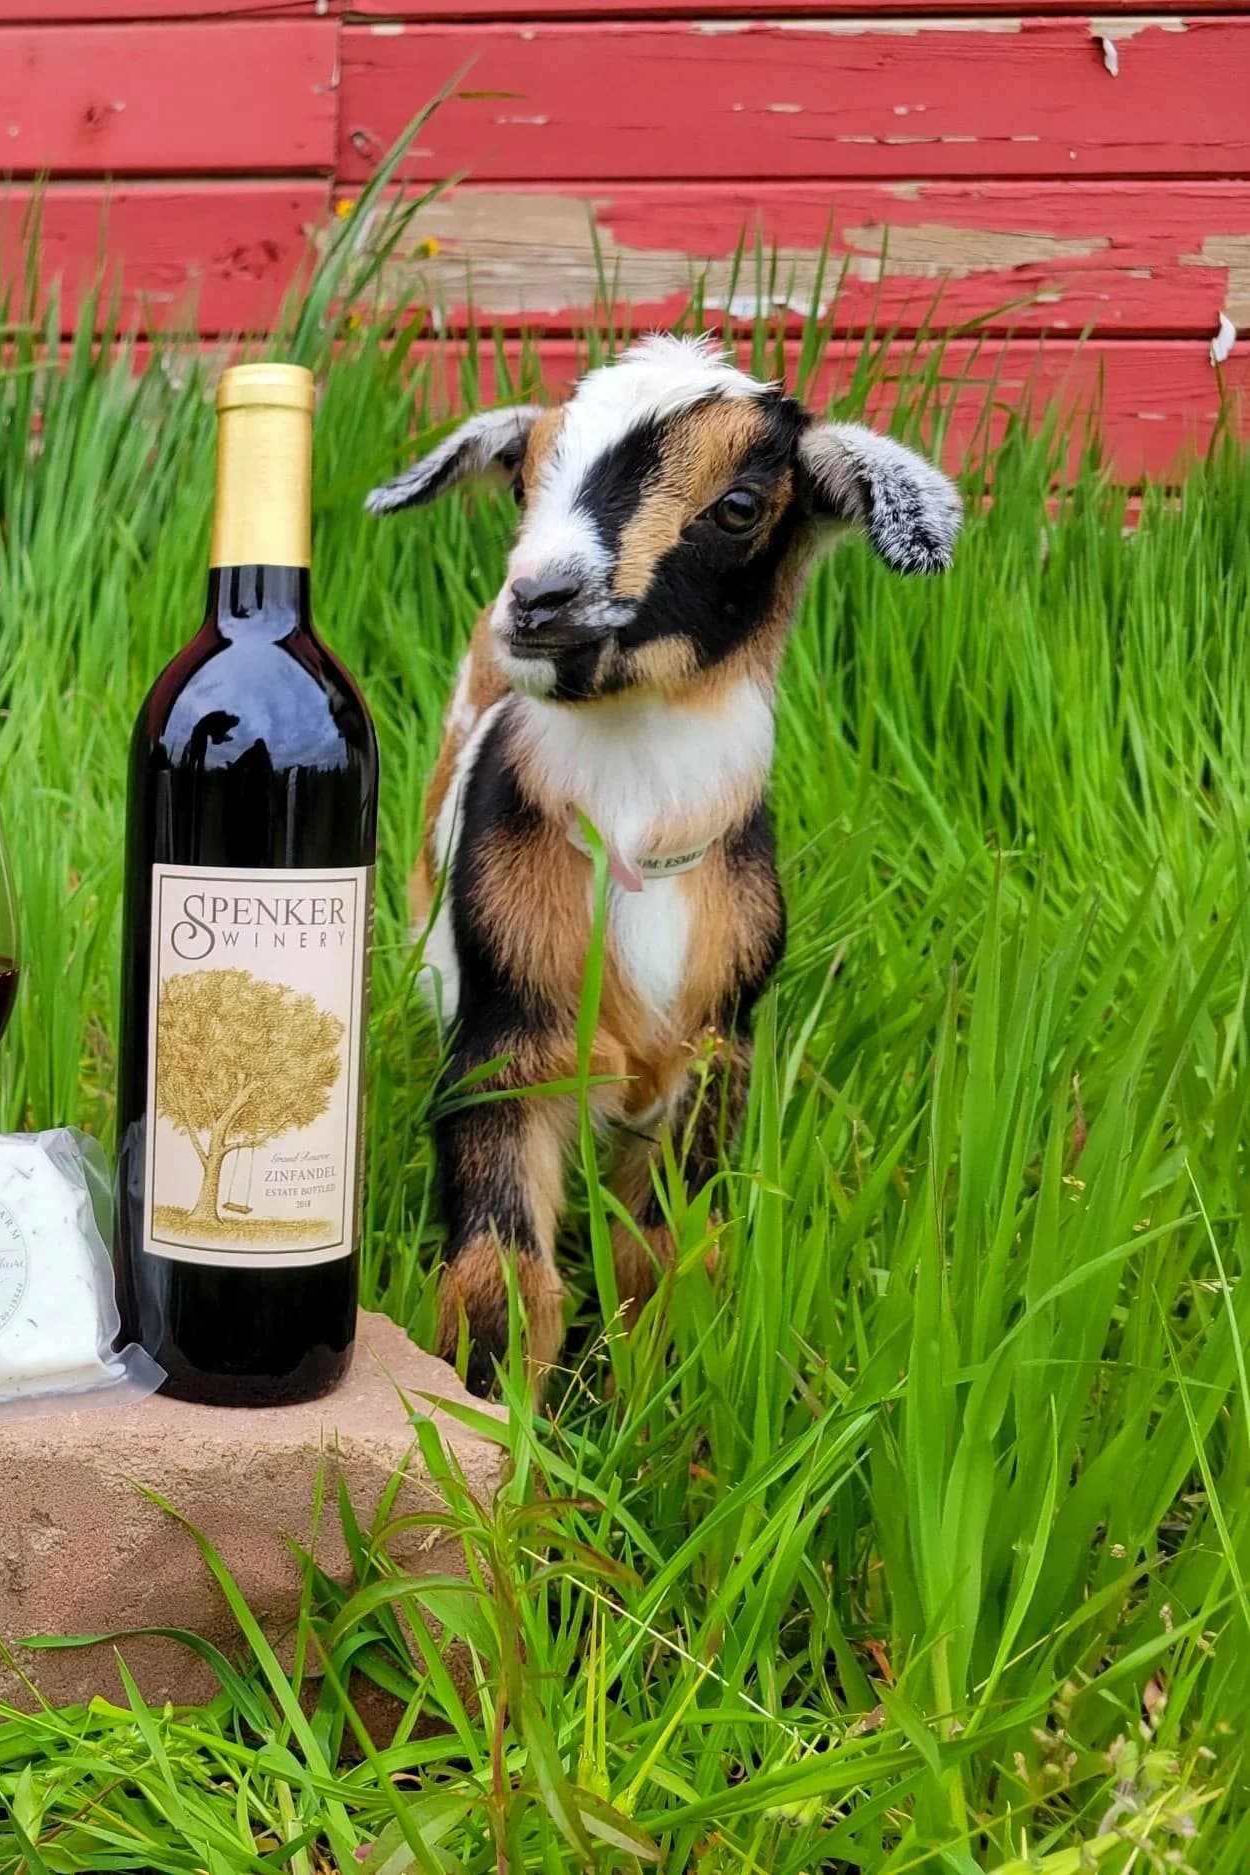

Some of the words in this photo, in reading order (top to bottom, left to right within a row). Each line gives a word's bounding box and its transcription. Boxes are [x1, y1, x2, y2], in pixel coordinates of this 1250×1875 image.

[171, 892, 346, 960] SPENKER
[222, 931, 345, 948] WINERY
[264, 1166, 338, 1182] ZINFANDEL
[265, 1188, 300, 1197] ESTATE
[301, 1184, 336, 1196] BOTTLED
